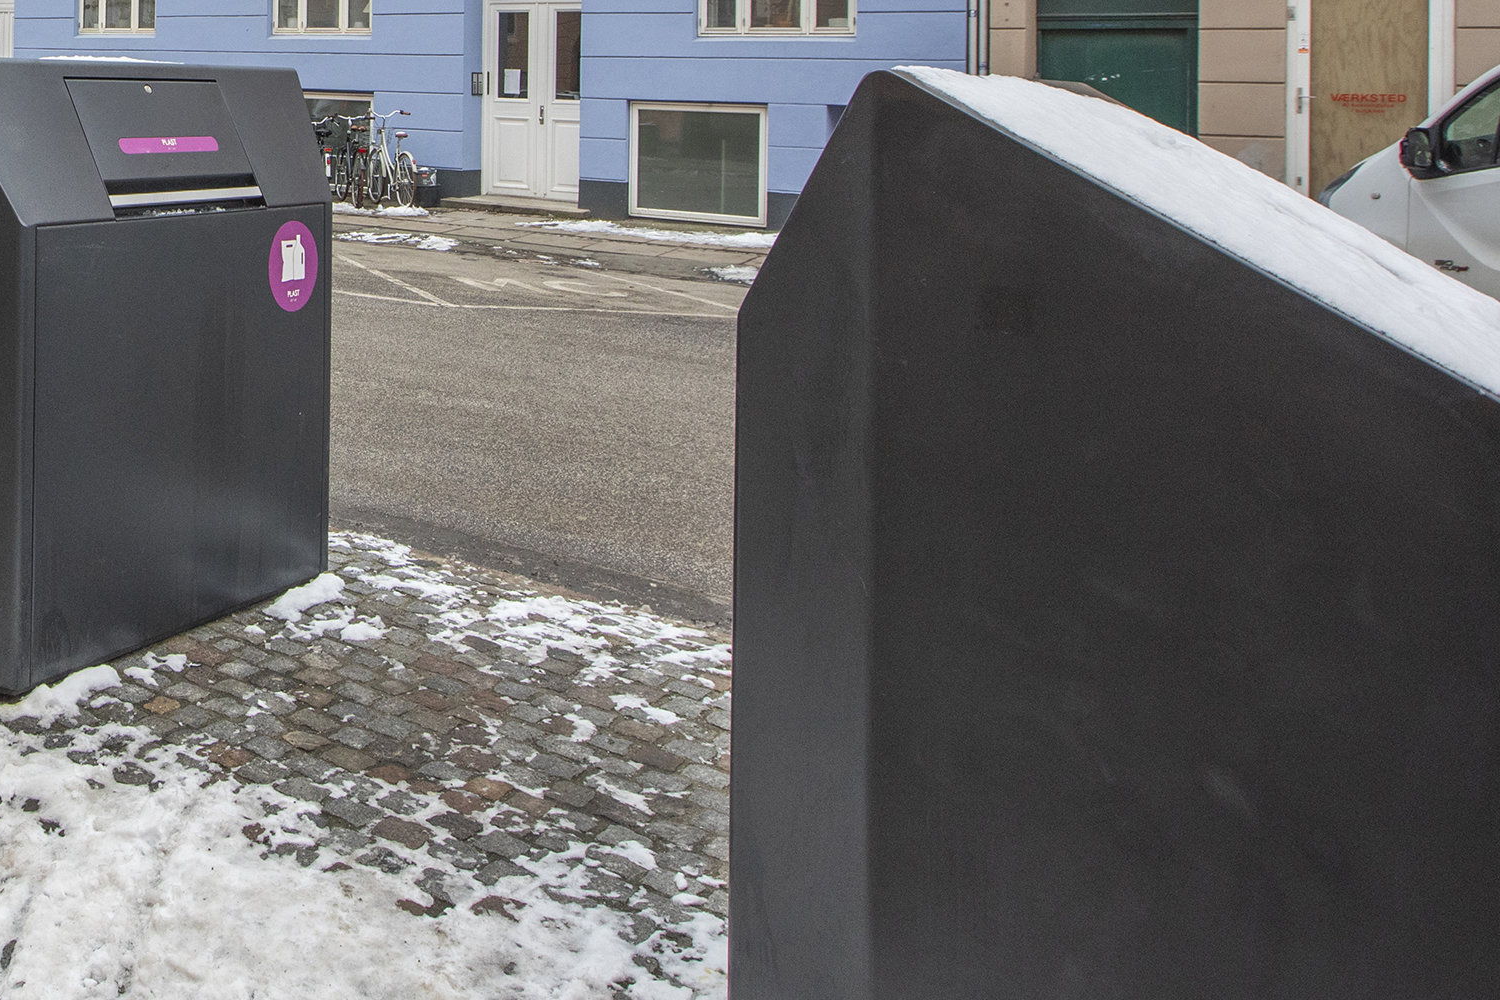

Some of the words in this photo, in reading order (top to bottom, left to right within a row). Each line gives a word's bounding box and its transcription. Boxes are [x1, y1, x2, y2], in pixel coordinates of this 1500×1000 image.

[1330, 93, 1407, 103] VÆRKSTED
[161, 138, 177, 146] PLAST
[287, 289, 300, 298] PLAST
